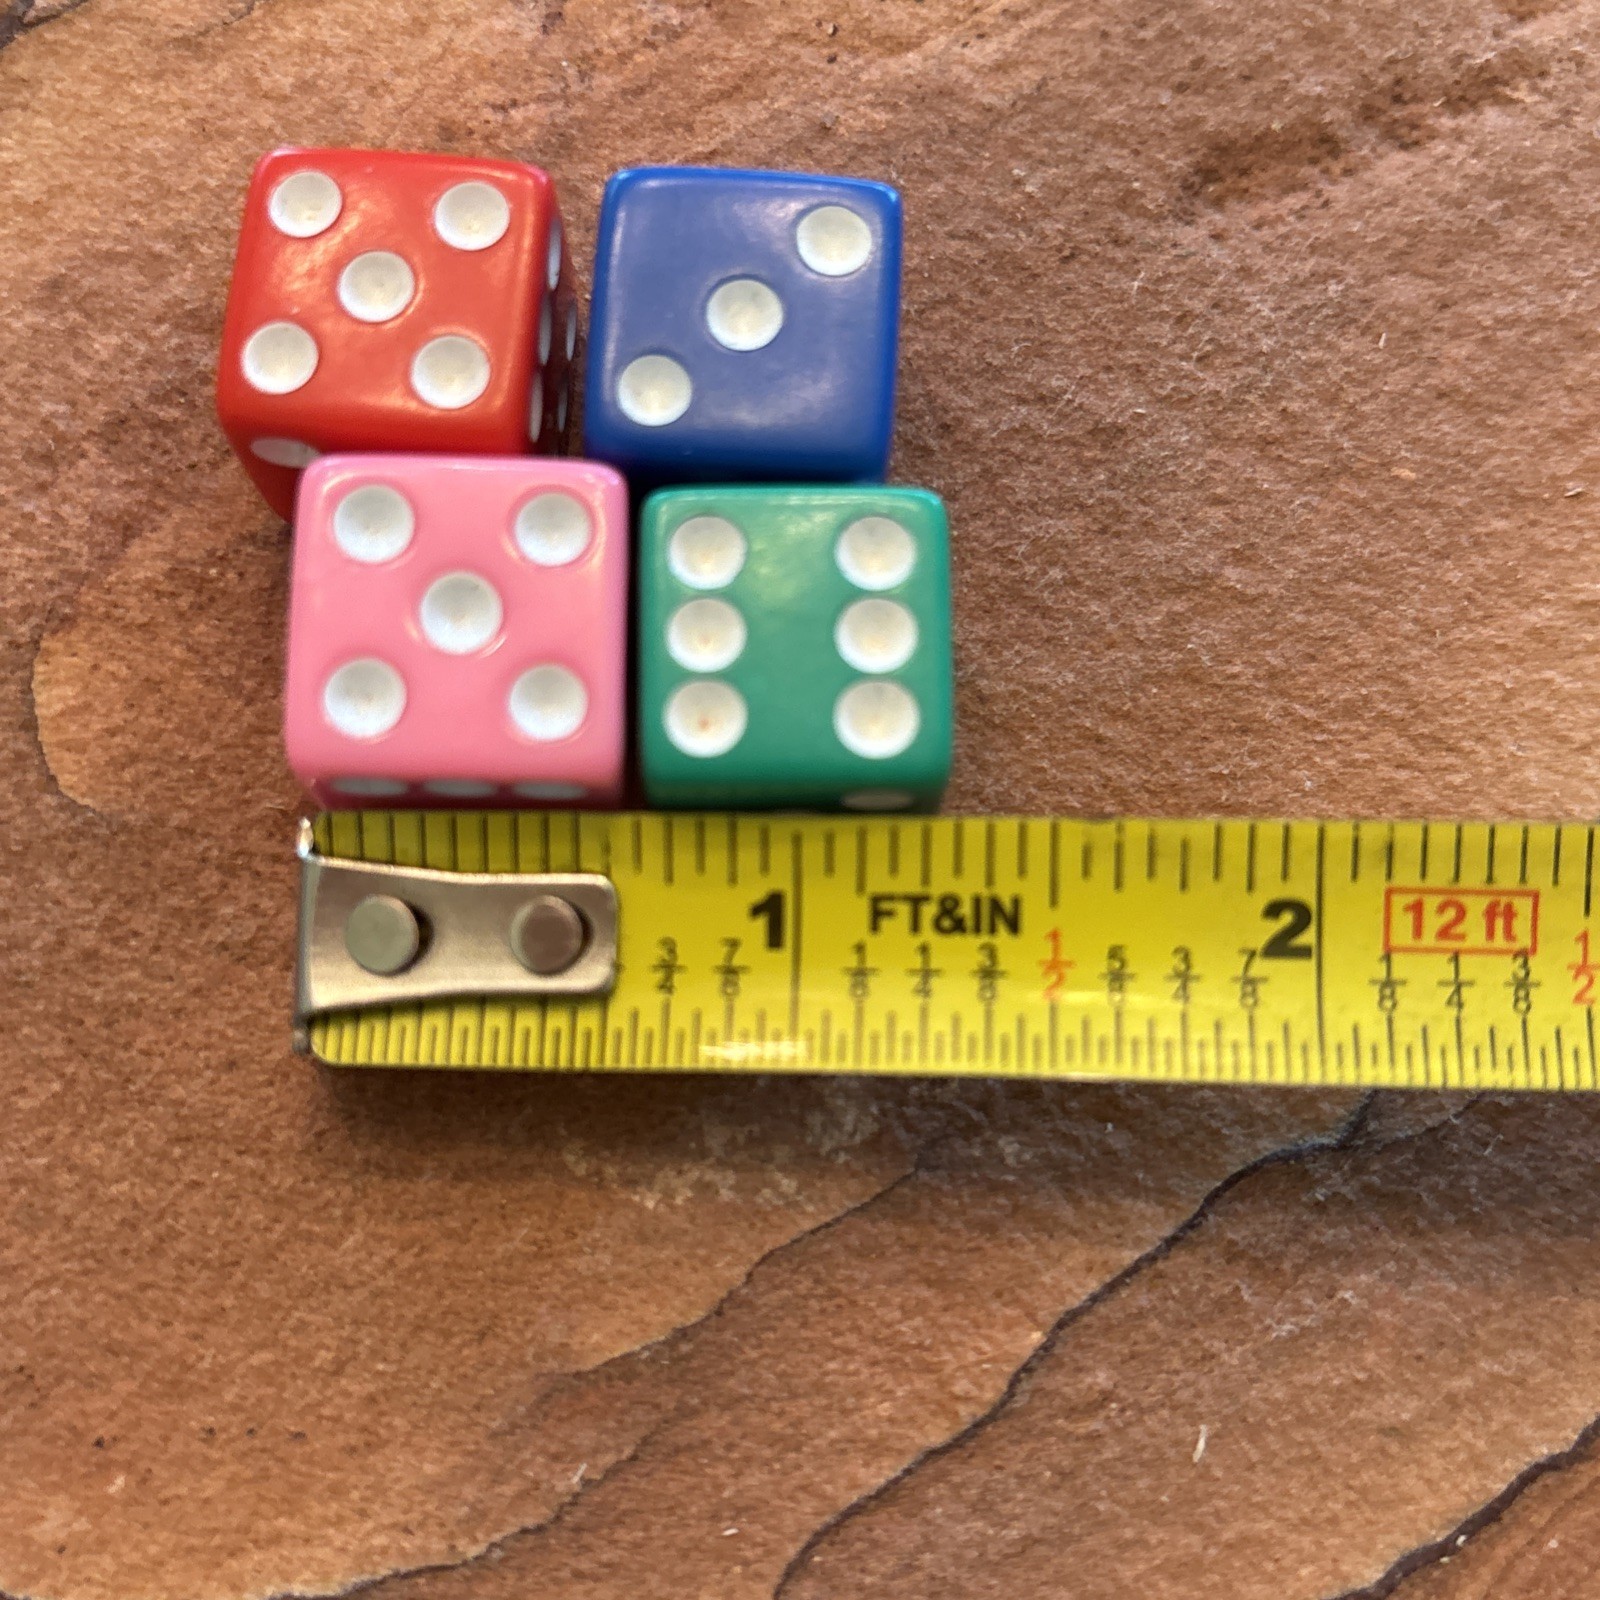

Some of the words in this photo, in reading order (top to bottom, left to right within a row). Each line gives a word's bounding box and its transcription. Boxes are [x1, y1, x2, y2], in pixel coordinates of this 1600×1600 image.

[749, 890, 785, 950] 1
[868, 893, 1022, 936] FT&IN
[1261, 897, 1313, 961] 2
[1403, 898, 1467, 942] 12
[1483, 899, 1519, 943] ft
